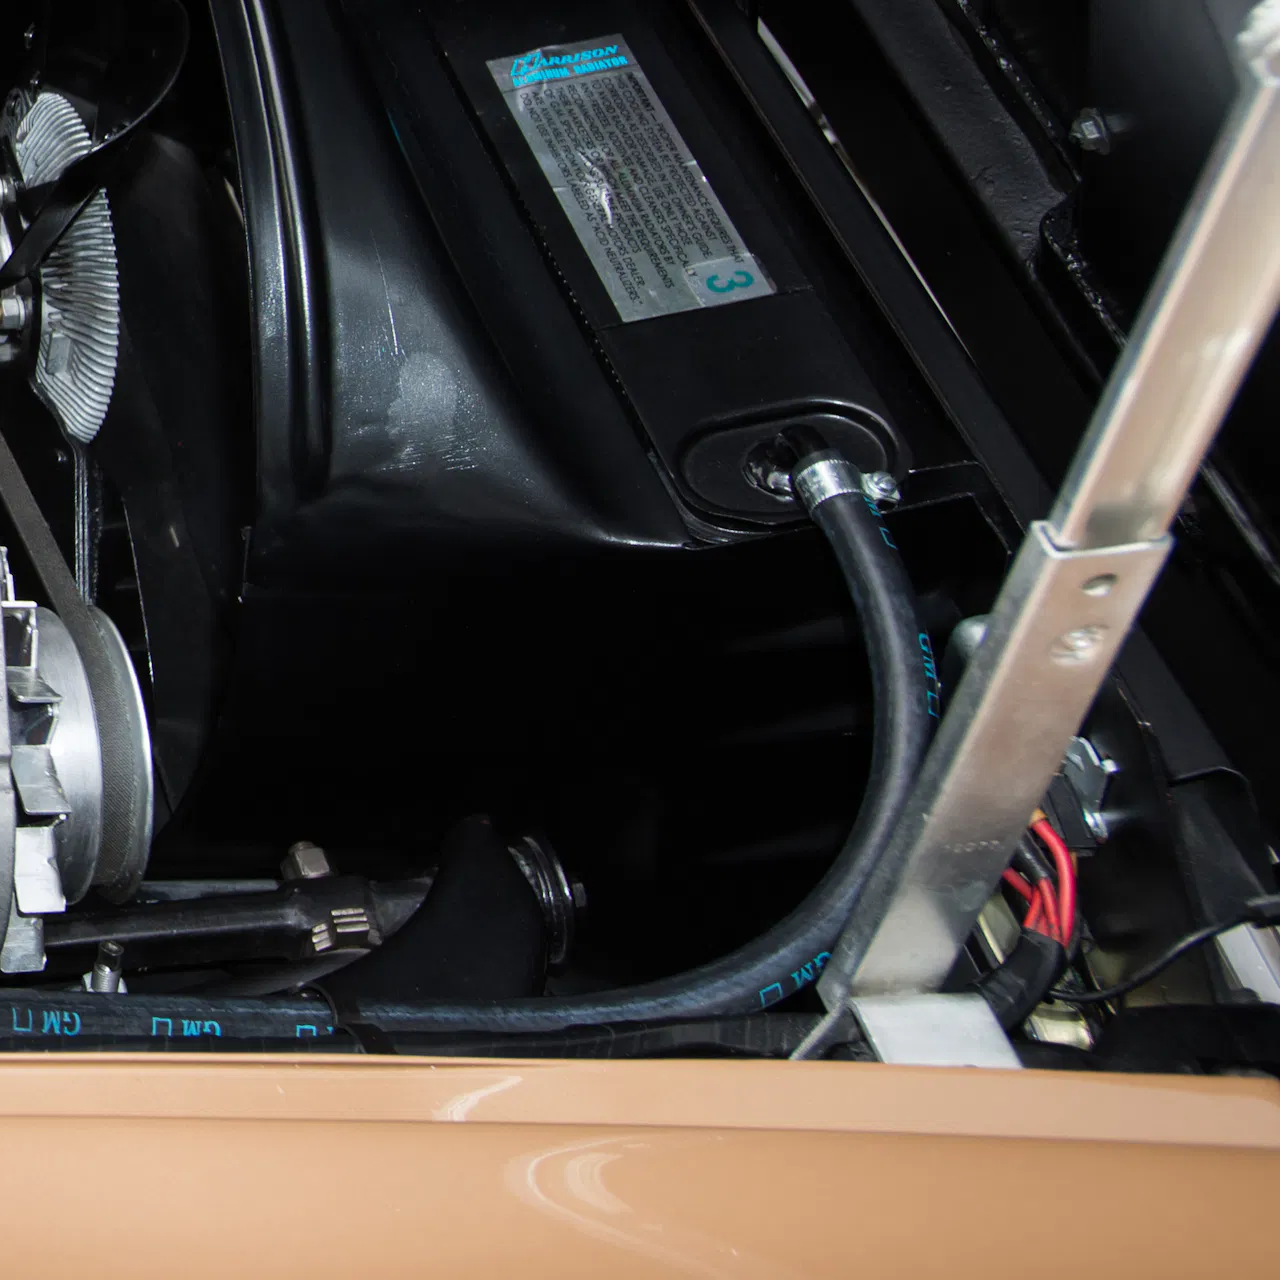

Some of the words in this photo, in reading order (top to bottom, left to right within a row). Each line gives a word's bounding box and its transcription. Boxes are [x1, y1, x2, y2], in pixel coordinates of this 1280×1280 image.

[572, 55, 629, 76] RADIATOR
[704, 268, 755, 295] 3
[42, 1010, 81, 1036] GM
